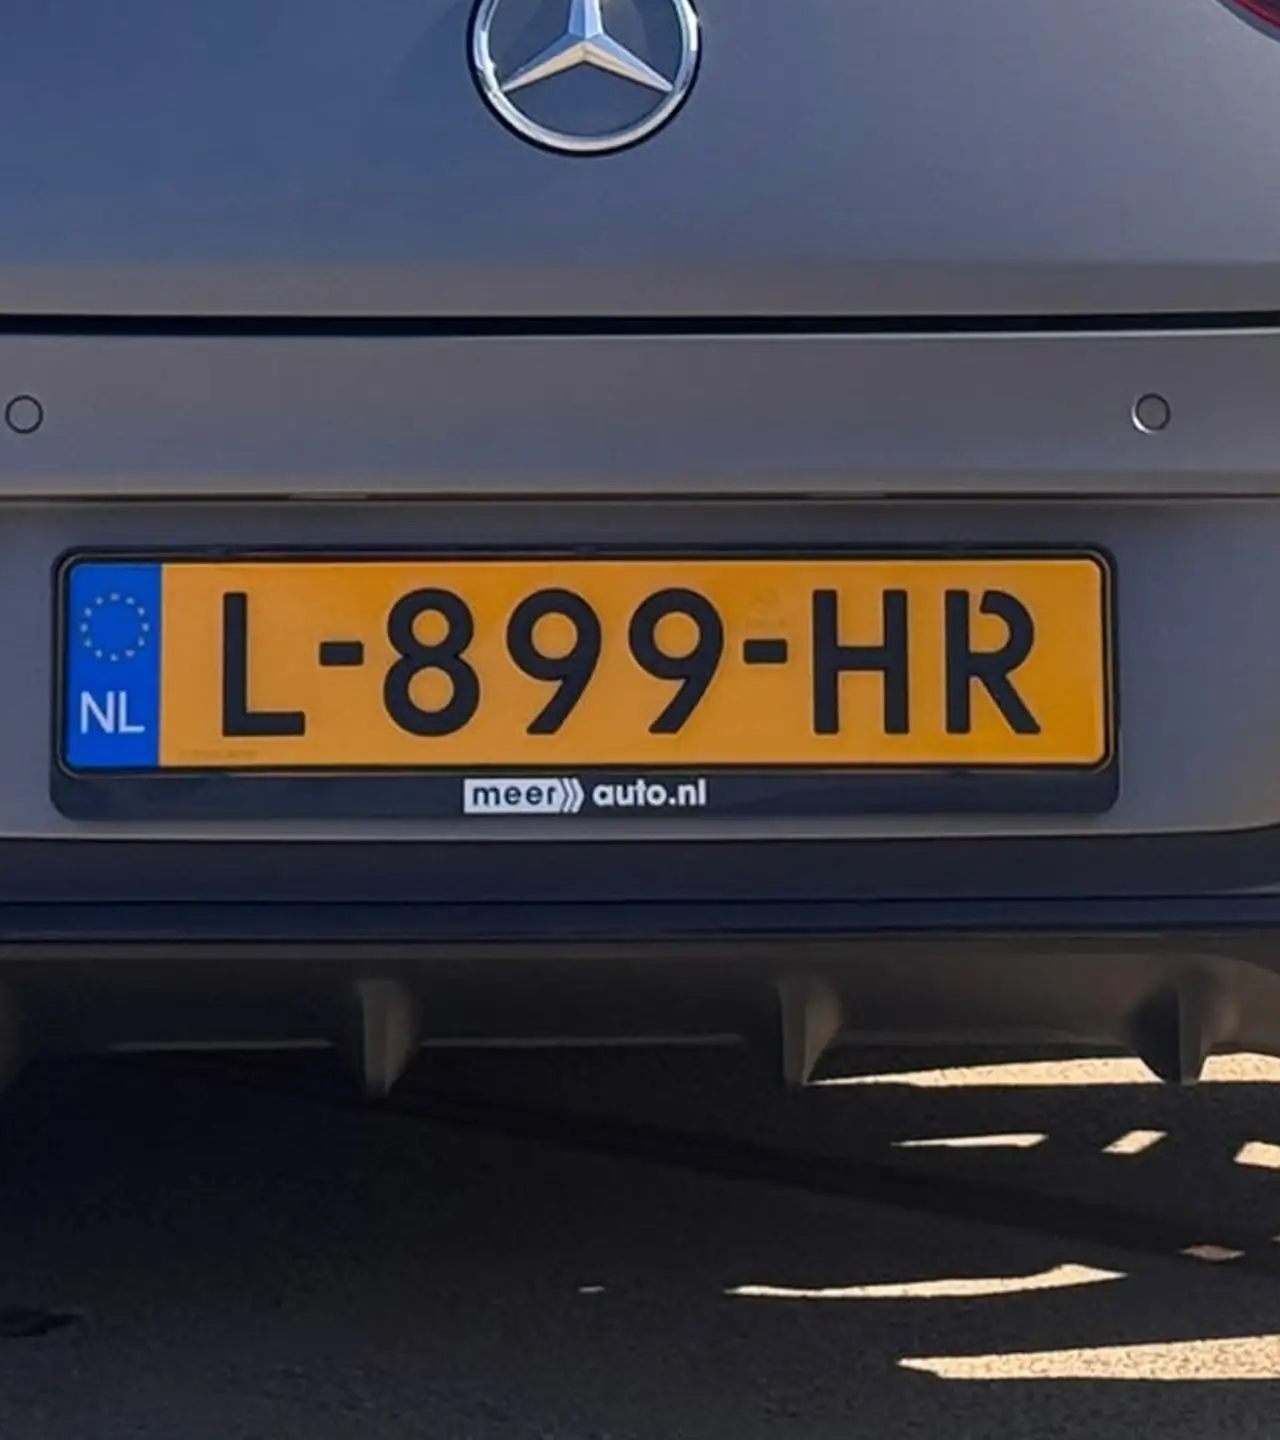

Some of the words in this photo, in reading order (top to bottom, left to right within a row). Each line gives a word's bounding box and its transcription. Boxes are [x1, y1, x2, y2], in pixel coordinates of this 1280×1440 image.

[221, 588, 1042, 738] L-899-HR
[80, 689, 146, 735] NL
[472, 785, 558, 806] meer
[592, 778, 707, 806] auto.nl
